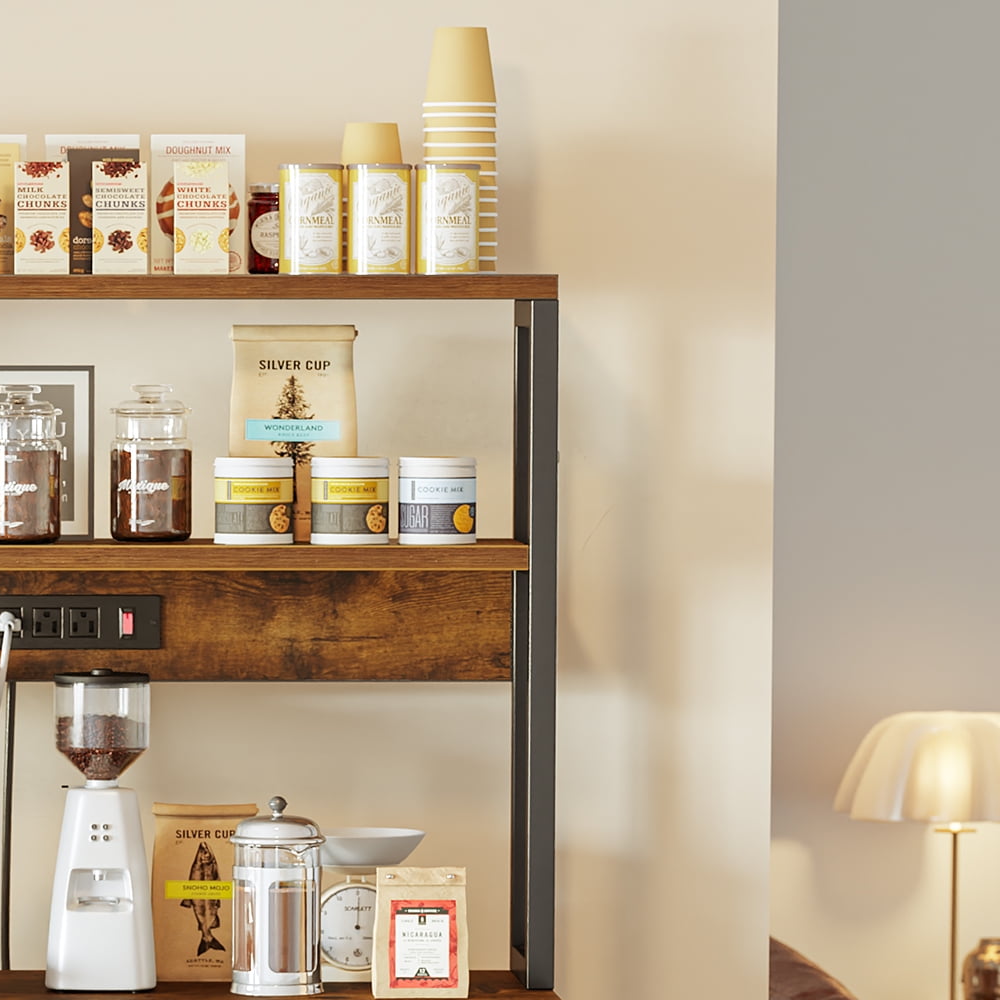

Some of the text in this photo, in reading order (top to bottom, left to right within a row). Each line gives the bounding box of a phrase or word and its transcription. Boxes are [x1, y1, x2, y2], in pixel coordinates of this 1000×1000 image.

[165, 146, 232, 155] DOUGHNUT MIX
[259, 360, 331, 370] SILVER CUP
[264, 424, 324, 432] WONDERLAND
[400, 504, 429, 529] SUGAR
[175, 830, 212, 839] SILVER
